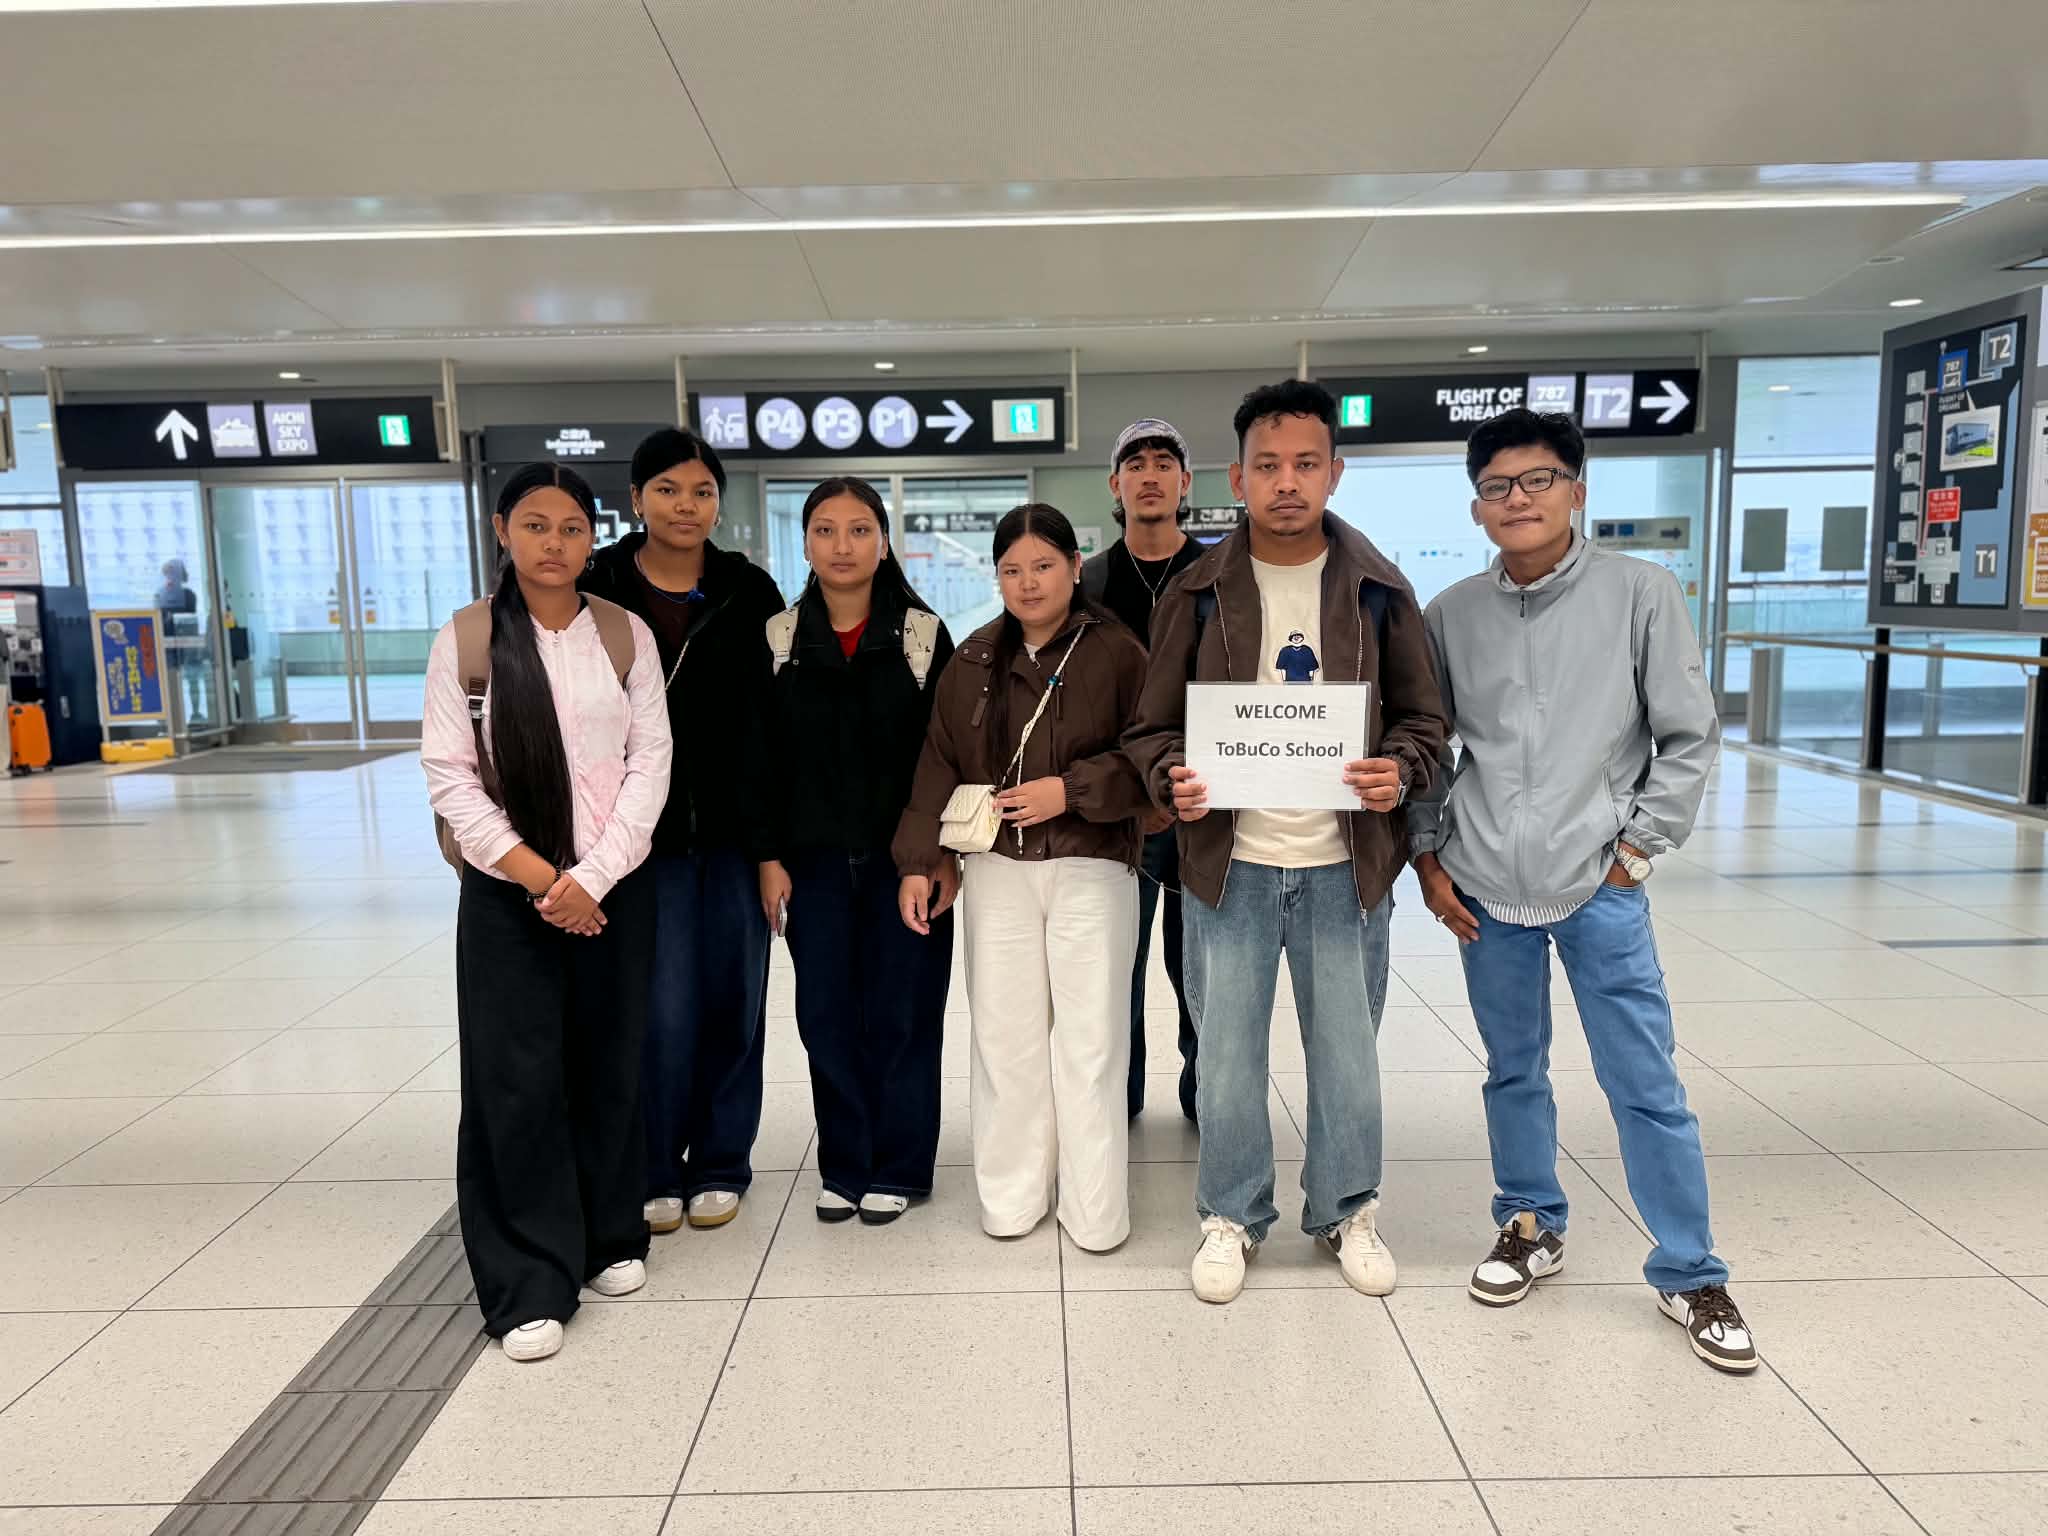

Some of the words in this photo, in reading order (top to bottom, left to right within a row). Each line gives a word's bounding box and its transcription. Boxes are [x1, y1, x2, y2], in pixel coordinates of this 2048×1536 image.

[1989, 334, 2012, 361] T2
[1436, 387, 1496, 406] FLIGHT
[1498, 387, 1523, 404] OF
[1536, 386, 1566, 401] 787
[1586, 387, 1631, 420] T2
[272, 411, 305, 425] AICHI
[761, 408, 801, 441] P4
[817, 407, 857, 440] P3
[874, 407, 913, 439] P1
[278, 424, 302, 438] SKY
[277, 438, 308, 452] EXPO
[1975, 549, 1997, 573] T1
[1235, 704, 1327, 719] WELCOME
[1216, 741, 1280, 757] ToBuCo
[1285, 741, 1344, 757] School
